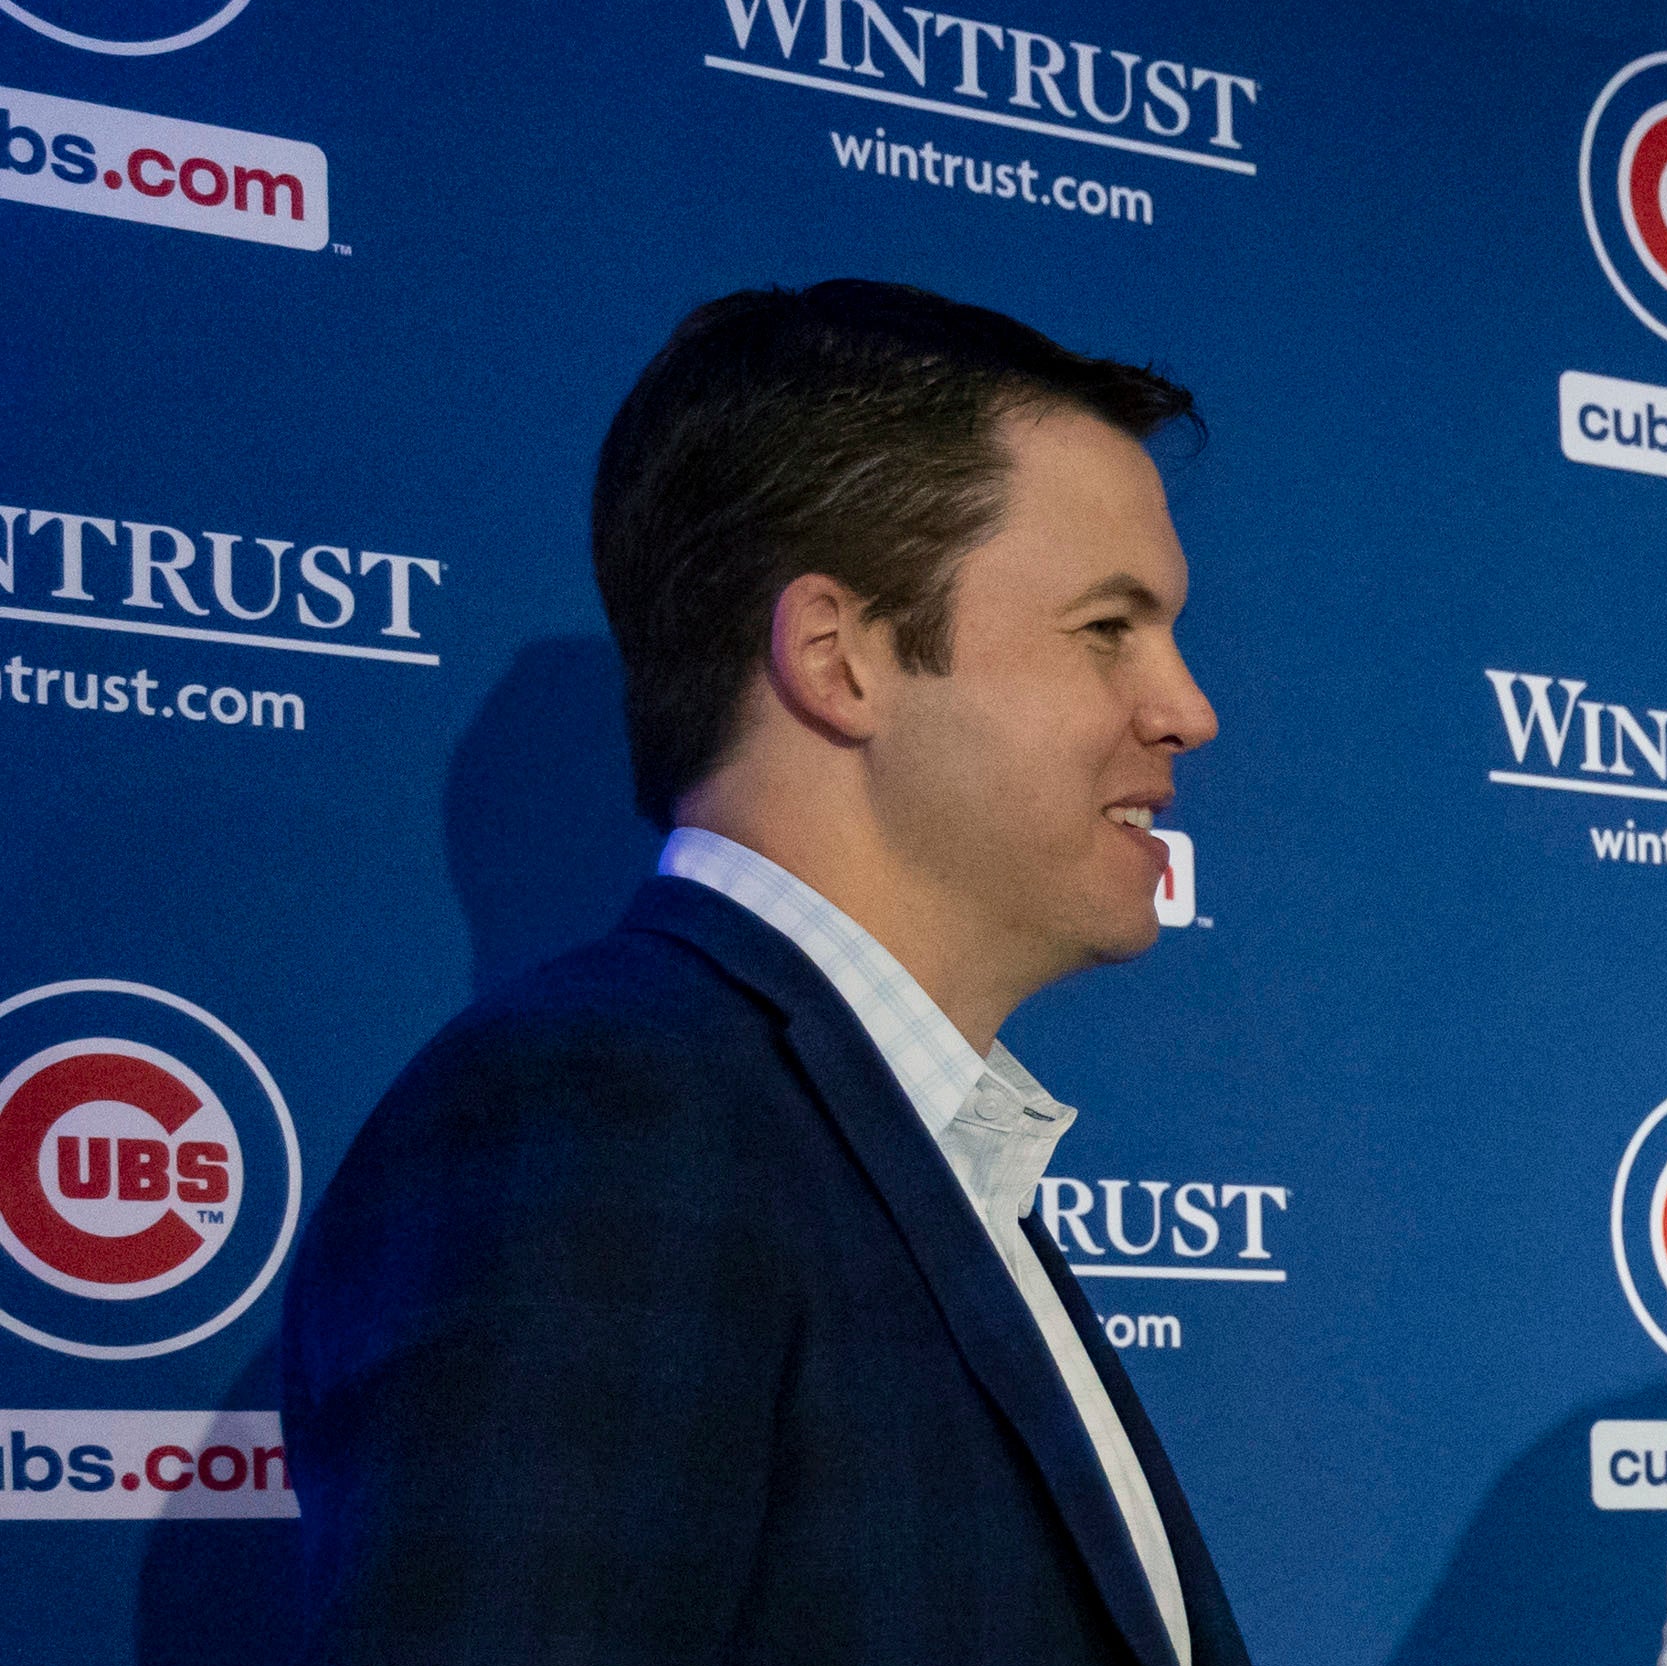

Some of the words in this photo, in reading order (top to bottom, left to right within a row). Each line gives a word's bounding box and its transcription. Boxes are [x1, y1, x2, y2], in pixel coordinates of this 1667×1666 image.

[0, 108, 304, 221] bs.com
[830, 127, 1153, 225] wintrust.com
[0, 505, 440, 638] TRUST
[0, 656, 304, 730] trust.com
[0, 1053, 229, 1284] CUBS
[1040, 1177, 1287, 1259] RUST
